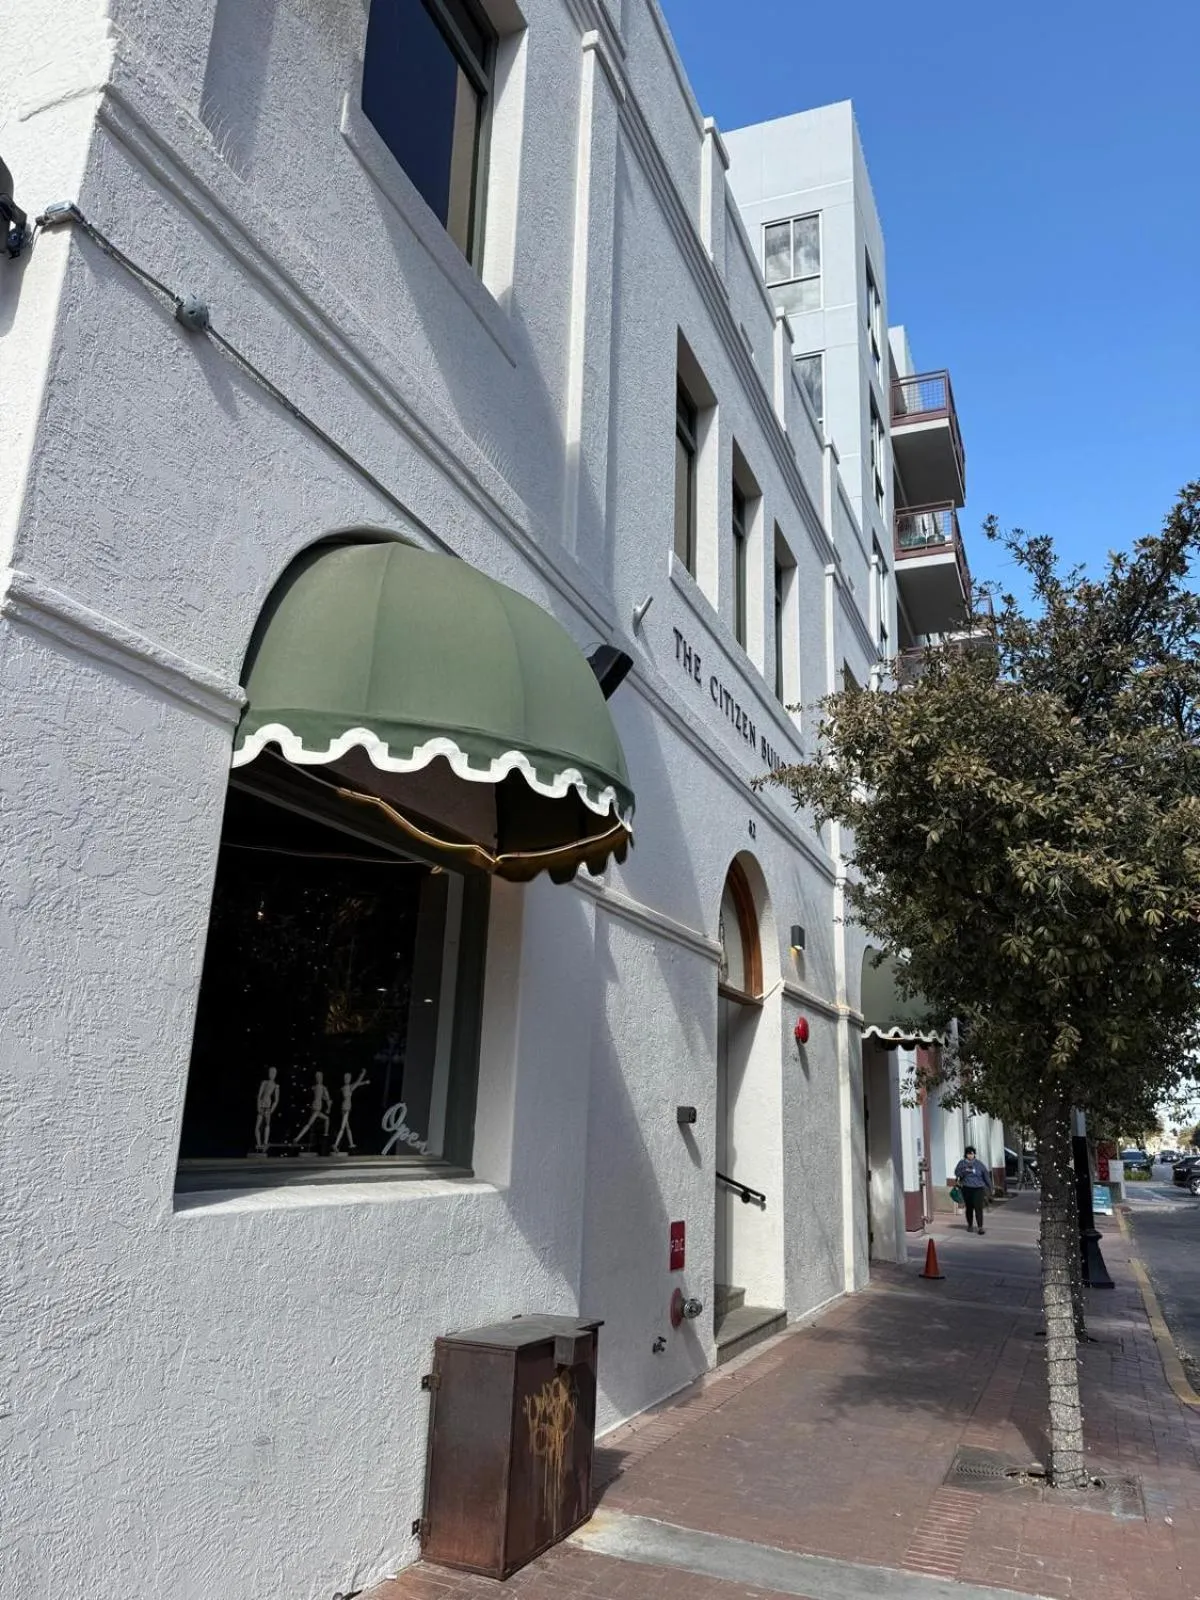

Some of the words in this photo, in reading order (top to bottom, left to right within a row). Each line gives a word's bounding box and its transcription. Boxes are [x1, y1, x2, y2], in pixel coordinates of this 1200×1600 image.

[673, 627, 701, 685] THE
[710, 675, 756, 749] CITIZEN
[381, 1102, 432, 1156] Open
